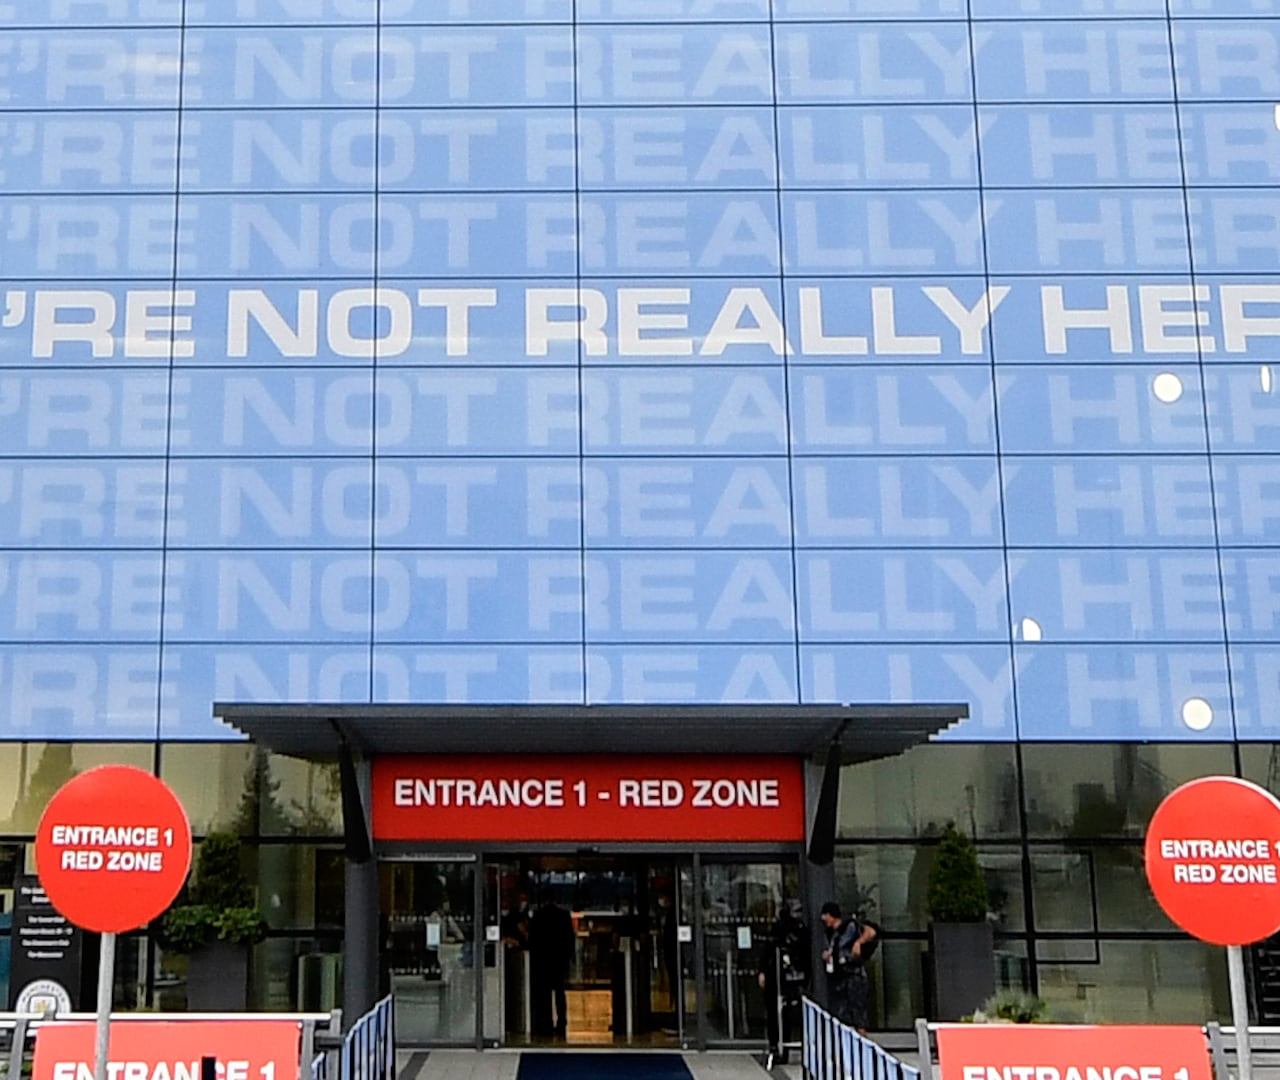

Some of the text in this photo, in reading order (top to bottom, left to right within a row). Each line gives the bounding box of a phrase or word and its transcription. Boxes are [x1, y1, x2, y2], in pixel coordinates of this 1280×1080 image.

[235, 36, 496, 100] NOT
[526, 32, 992, 100] REALLY
[231, 119, 496, 184] NOT
[526, 116, 997, 183] REALLY
[228, 203, 496, 269] NOT
[526, 200, 1004, 268] REALLY
[226, 289, 497, 357] NOT
[526, 287, 1011, 356] REALLY
[223, 376, 496, 447] NOT
[526, 376, 1016, 447] REALLY
[221, 466, 497, 539] NOT
[527, 465, 1020, 538] REALLY
[216, 558, 497, 631] NOT
[528, 558, 1027, 631] REALLY
[393, 778, 564, 807] ENTRANCE
[572, 779, 587, 807] 1
[619, 779, 684, 807] RED
[692, 779, 780, 807] ZONE
[52, 825, 173, 847] ENTRANCE 1
[61, 850, 163, 872] RED ZONE
[1160, 839, 1270, 859] ENTRANCE
[1173, 864, 1278, 884] RED ZONE
